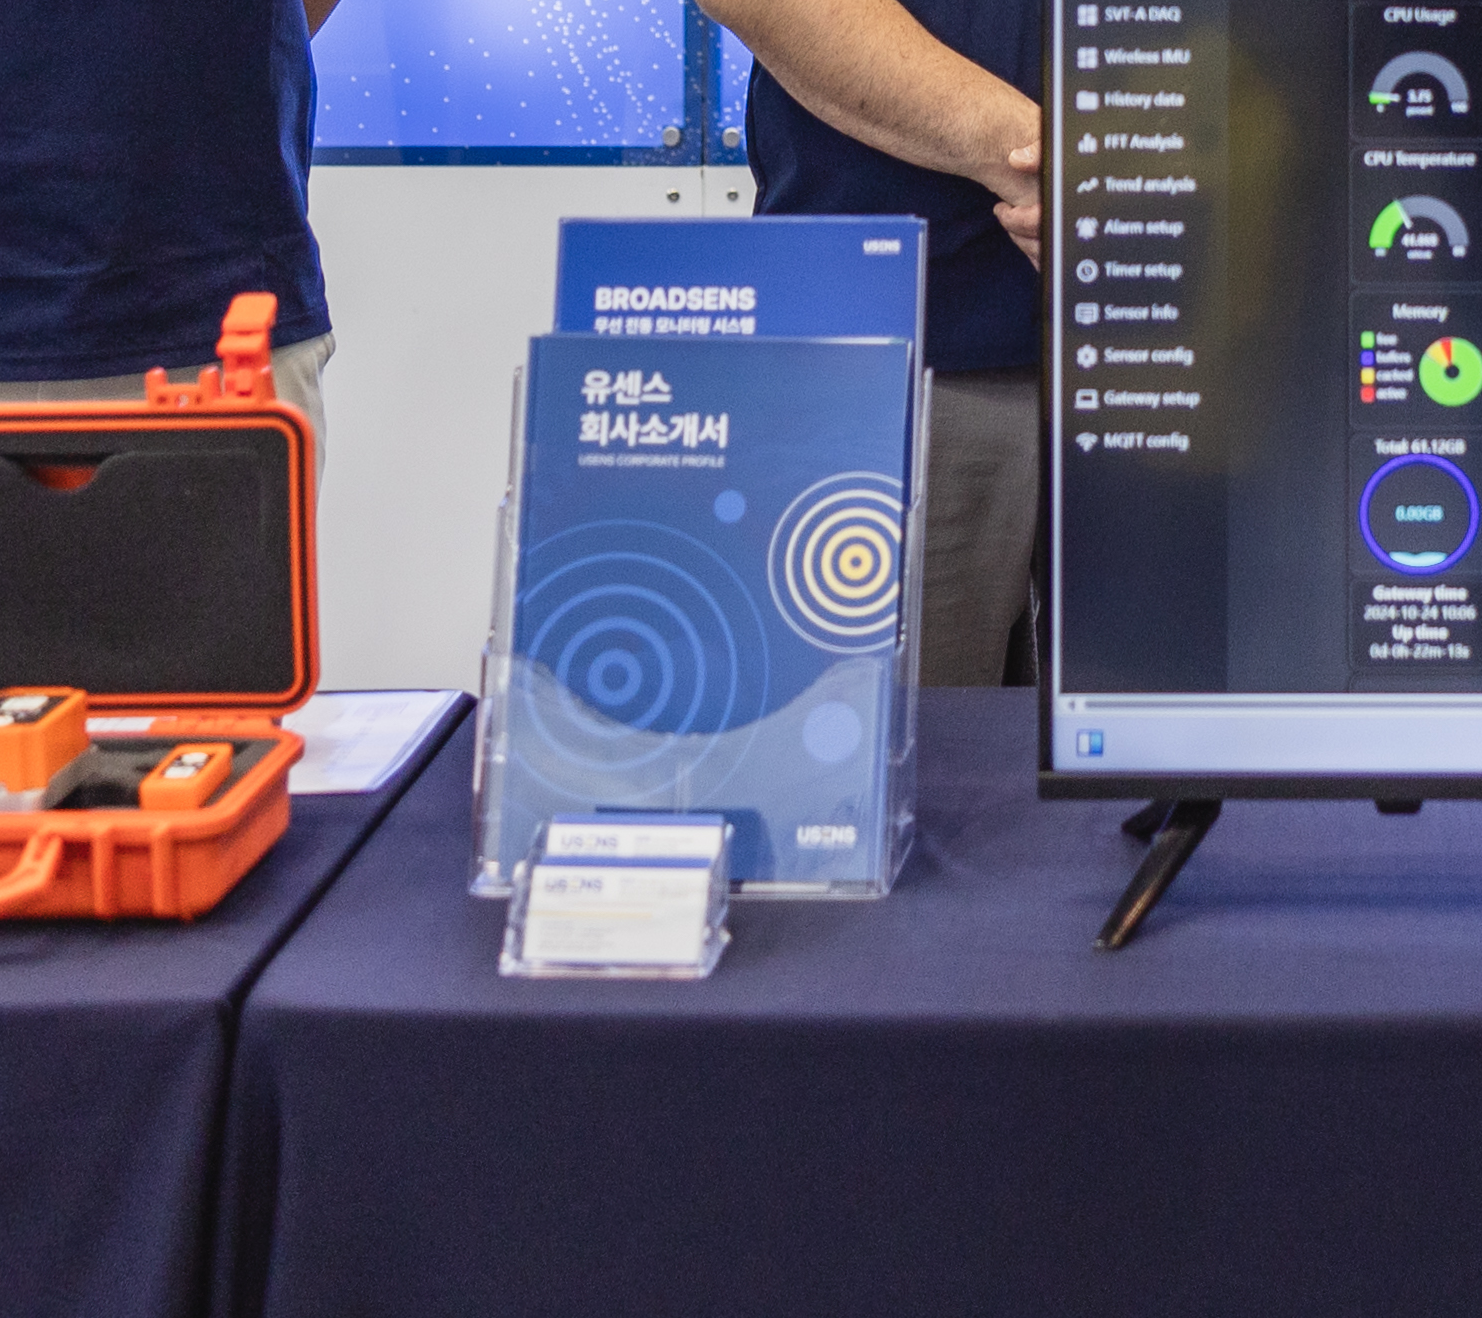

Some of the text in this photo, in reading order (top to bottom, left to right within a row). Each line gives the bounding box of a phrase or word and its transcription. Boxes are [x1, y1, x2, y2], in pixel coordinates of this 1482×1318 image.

[594, 286, 757, 312] BROADSENS
[594, 317, 623, 335] 무선
[581, 370, 672, 406] 유센스
[578, 412, 729, 449] 회사소개서
[796, 825, 857, 849] USENS
